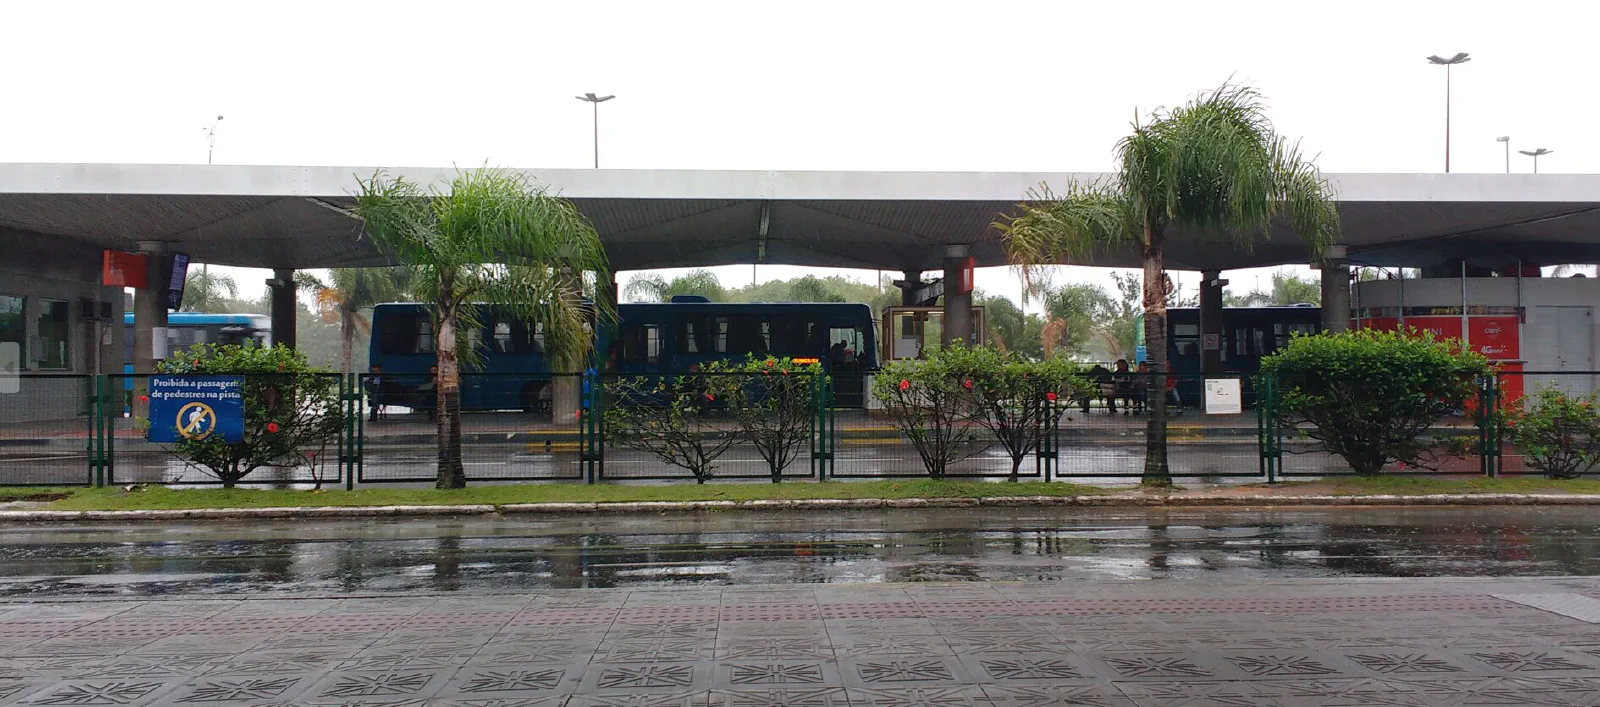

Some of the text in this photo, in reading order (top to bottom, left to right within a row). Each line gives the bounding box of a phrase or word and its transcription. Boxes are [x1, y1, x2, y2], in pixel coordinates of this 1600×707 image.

[153, 378, 190, 387] Proibida
[152, 390, 162, 398] de
[164, 390, 206, 401] pedestres
[219, 390, 241, 401] pista
